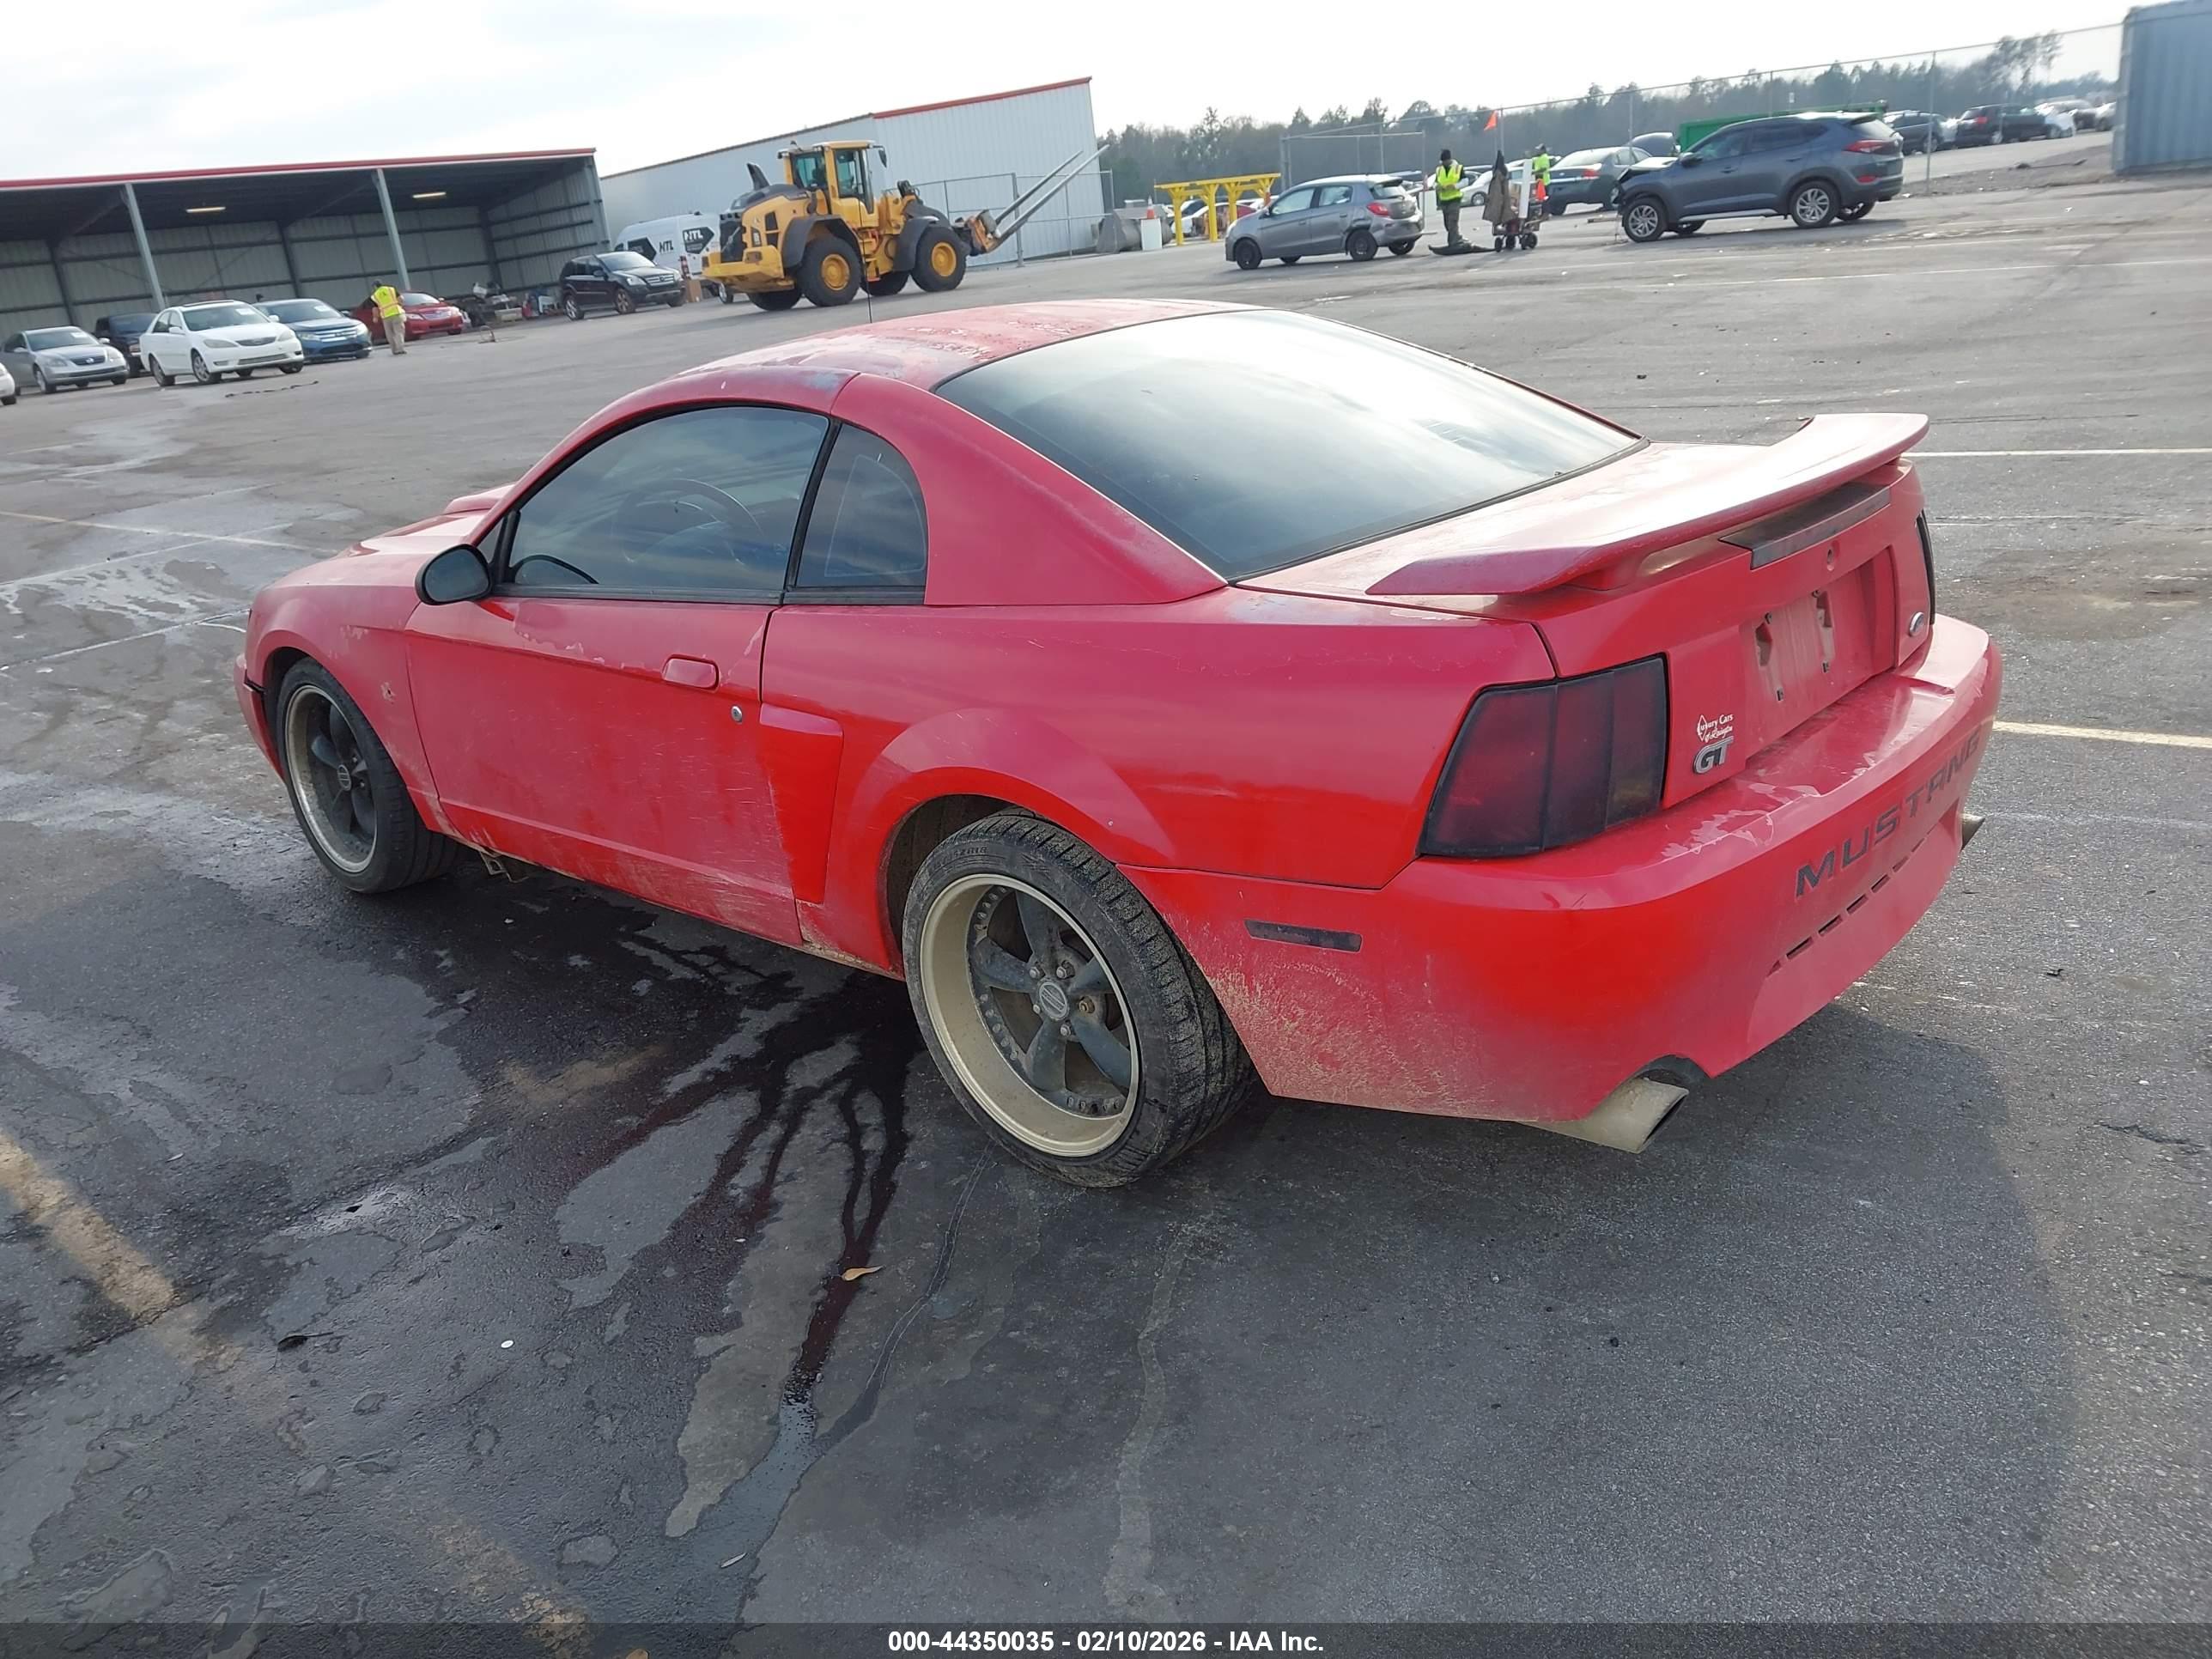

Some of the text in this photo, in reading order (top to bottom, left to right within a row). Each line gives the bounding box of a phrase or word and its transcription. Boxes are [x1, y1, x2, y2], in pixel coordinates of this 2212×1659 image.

[1719, 714, 1734, 725] Cars
[1693, 736, 1734, 774] GT
[1796, 728, 1980, 897] MUSTANG
